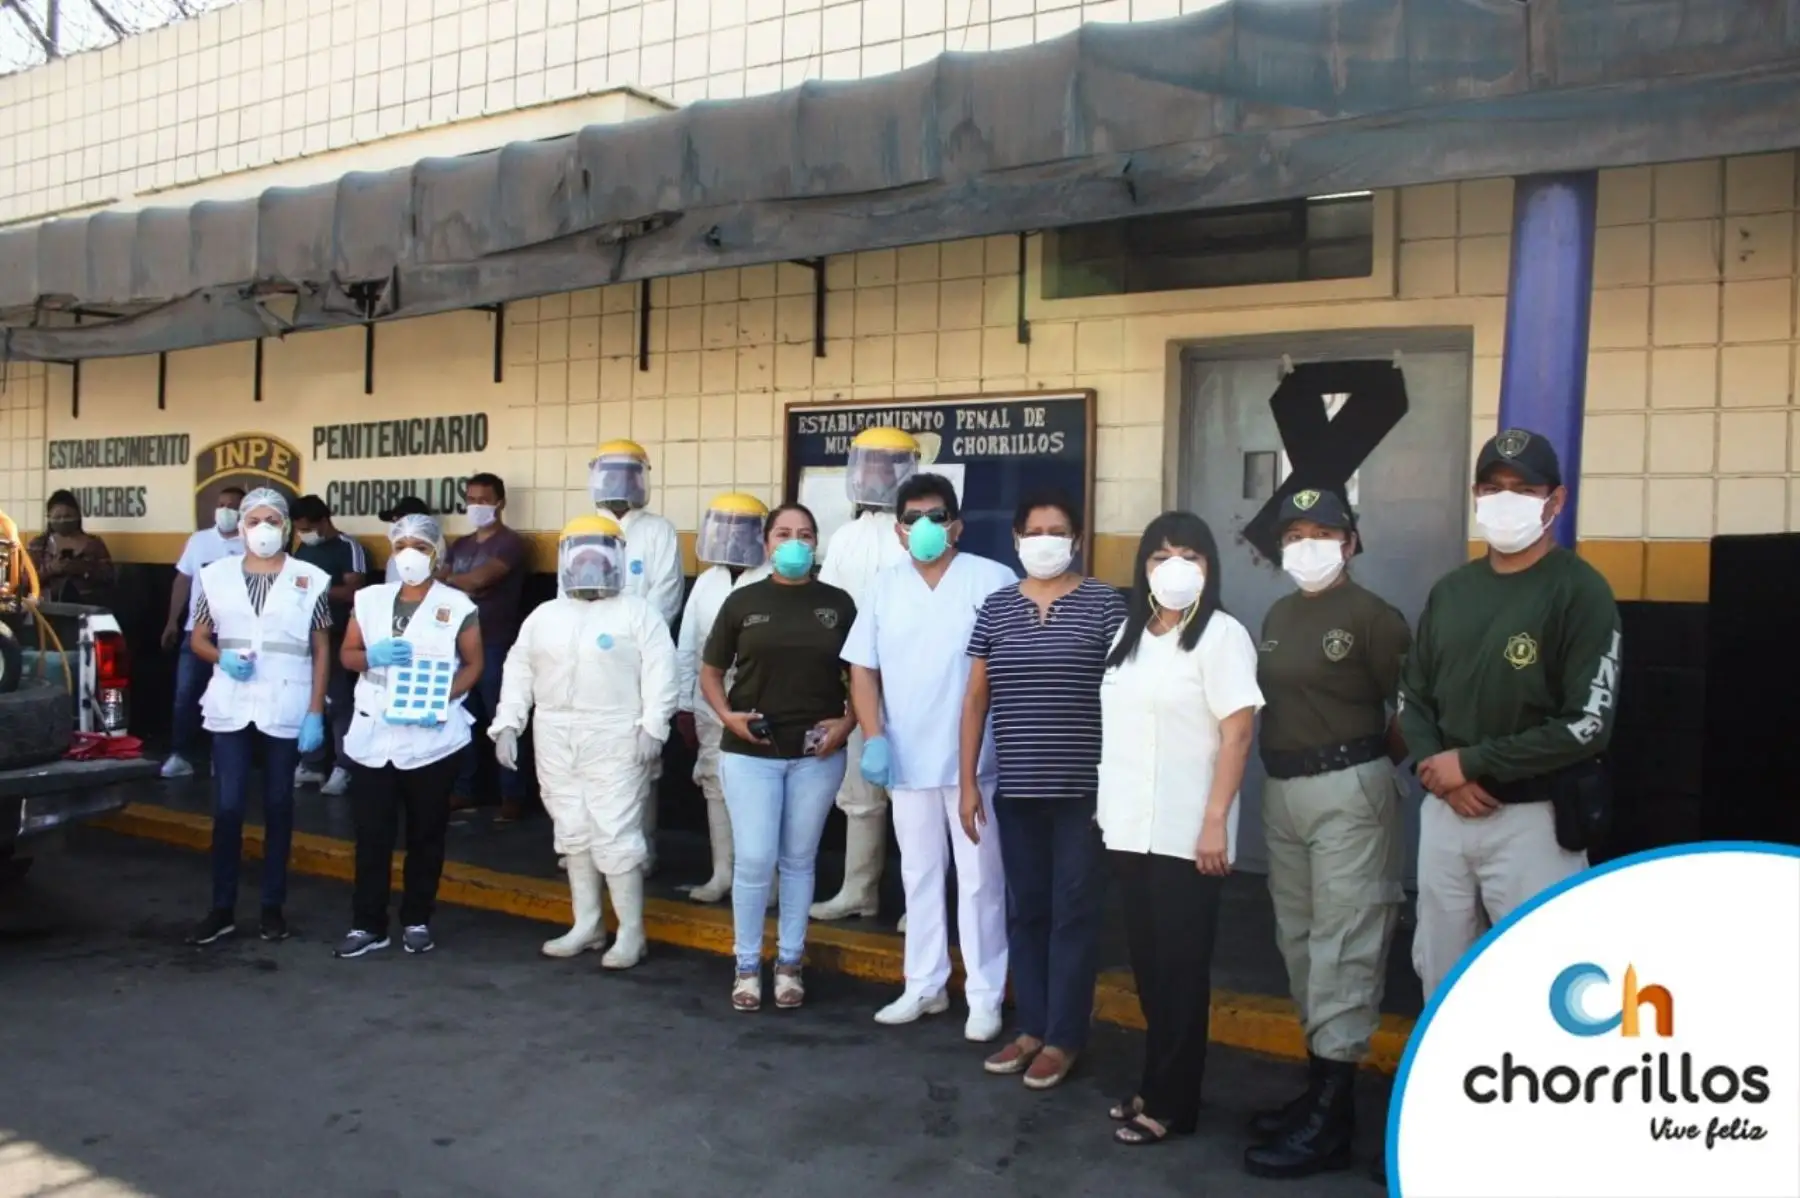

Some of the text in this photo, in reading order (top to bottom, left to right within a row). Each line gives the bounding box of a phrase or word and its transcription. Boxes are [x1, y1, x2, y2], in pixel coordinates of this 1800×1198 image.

[312, 412, 489, 460] PENITENCIARIO
[797, 407, 1046, 433] ESTABLECIMIENTO PENAL DE
[48, 433, 190, 469] ESTABLECIMIENTO
[215, 439, 292, 476] INPE
[953, 431, 1065, 456] CHORRILLOS
[1567, 629, 1622, 745] INPE
